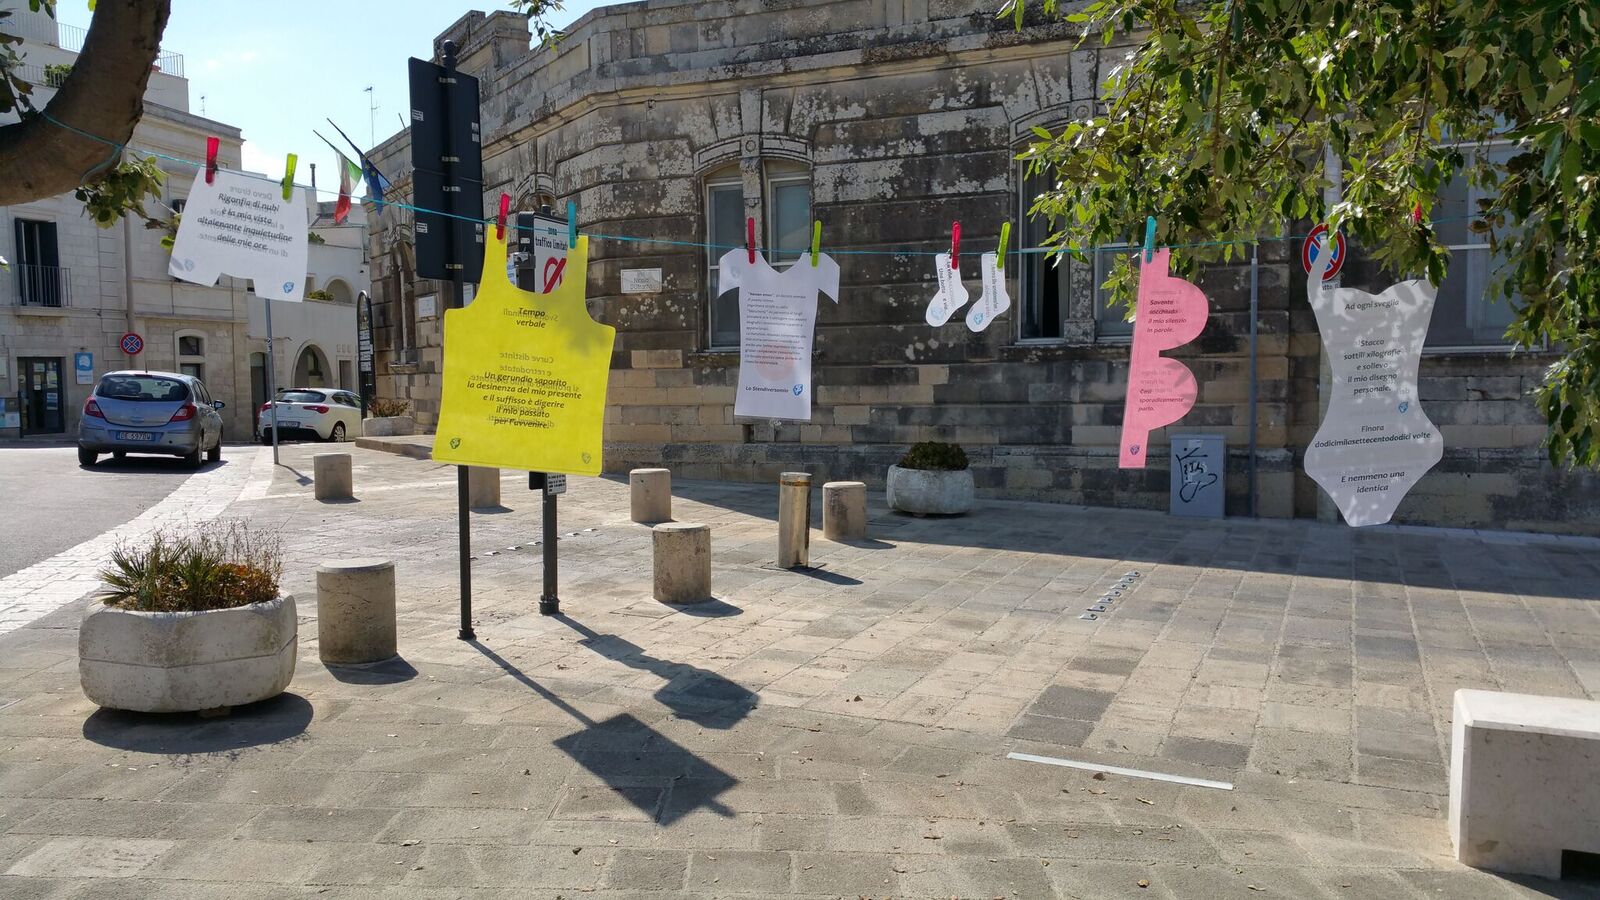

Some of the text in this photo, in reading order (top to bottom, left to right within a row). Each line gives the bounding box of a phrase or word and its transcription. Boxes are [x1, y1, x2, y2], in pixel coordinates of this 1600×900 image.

[218, 192, 280, 212] Rigonfia di nubi
[227, 208, 236, 216] la
[236, 212, 252, 220] mia
[253, 214, 272, 224] vista
[197, 216, 293, 242] altalenante inquietudine
[216, 234, 236, 244] delle
[237, 239, 252, 247] mie
[535, 236, 551, 248] traffico
[1356, 301, 1373, 310] ogni
[1374, 299, 1400, 308] sveglia
[519, 307, 546, 318] Tempo
[516, 319, 546, 328] verbale
[1360, 338, 1384, 347] Stacco
[1344, 349, 1401, 360] sottili xilografie
[1363, 362, 1388, 370] sollevo
[484, 371, 567, 387] Un gerundio saporito
[1369, 373, 1397, 382] disegno
[476, 382, 516, 392] desinenza
[518, 386, 528, 394] del
[531, 387, 546, 396] mio
[548, 390, 582, 400] presente
[1354, 386, 1391, 395] personale.
[490, 394, 495, 402] il
[496, 395, 526, 405] suffisso
[534, 398, 565, 410] digerire
[496, 405, 502, 413] il
[519, 409, 550, 418] passato
[494, 418, 508, 426] per
[1314, 431, 1431, 448] dodicimilasettecentododici volte
[1348, 472, 1388, 482] nemmeno
[1390, 470, 1405, 478] una
[1356, 484, 1388, 494] identica
